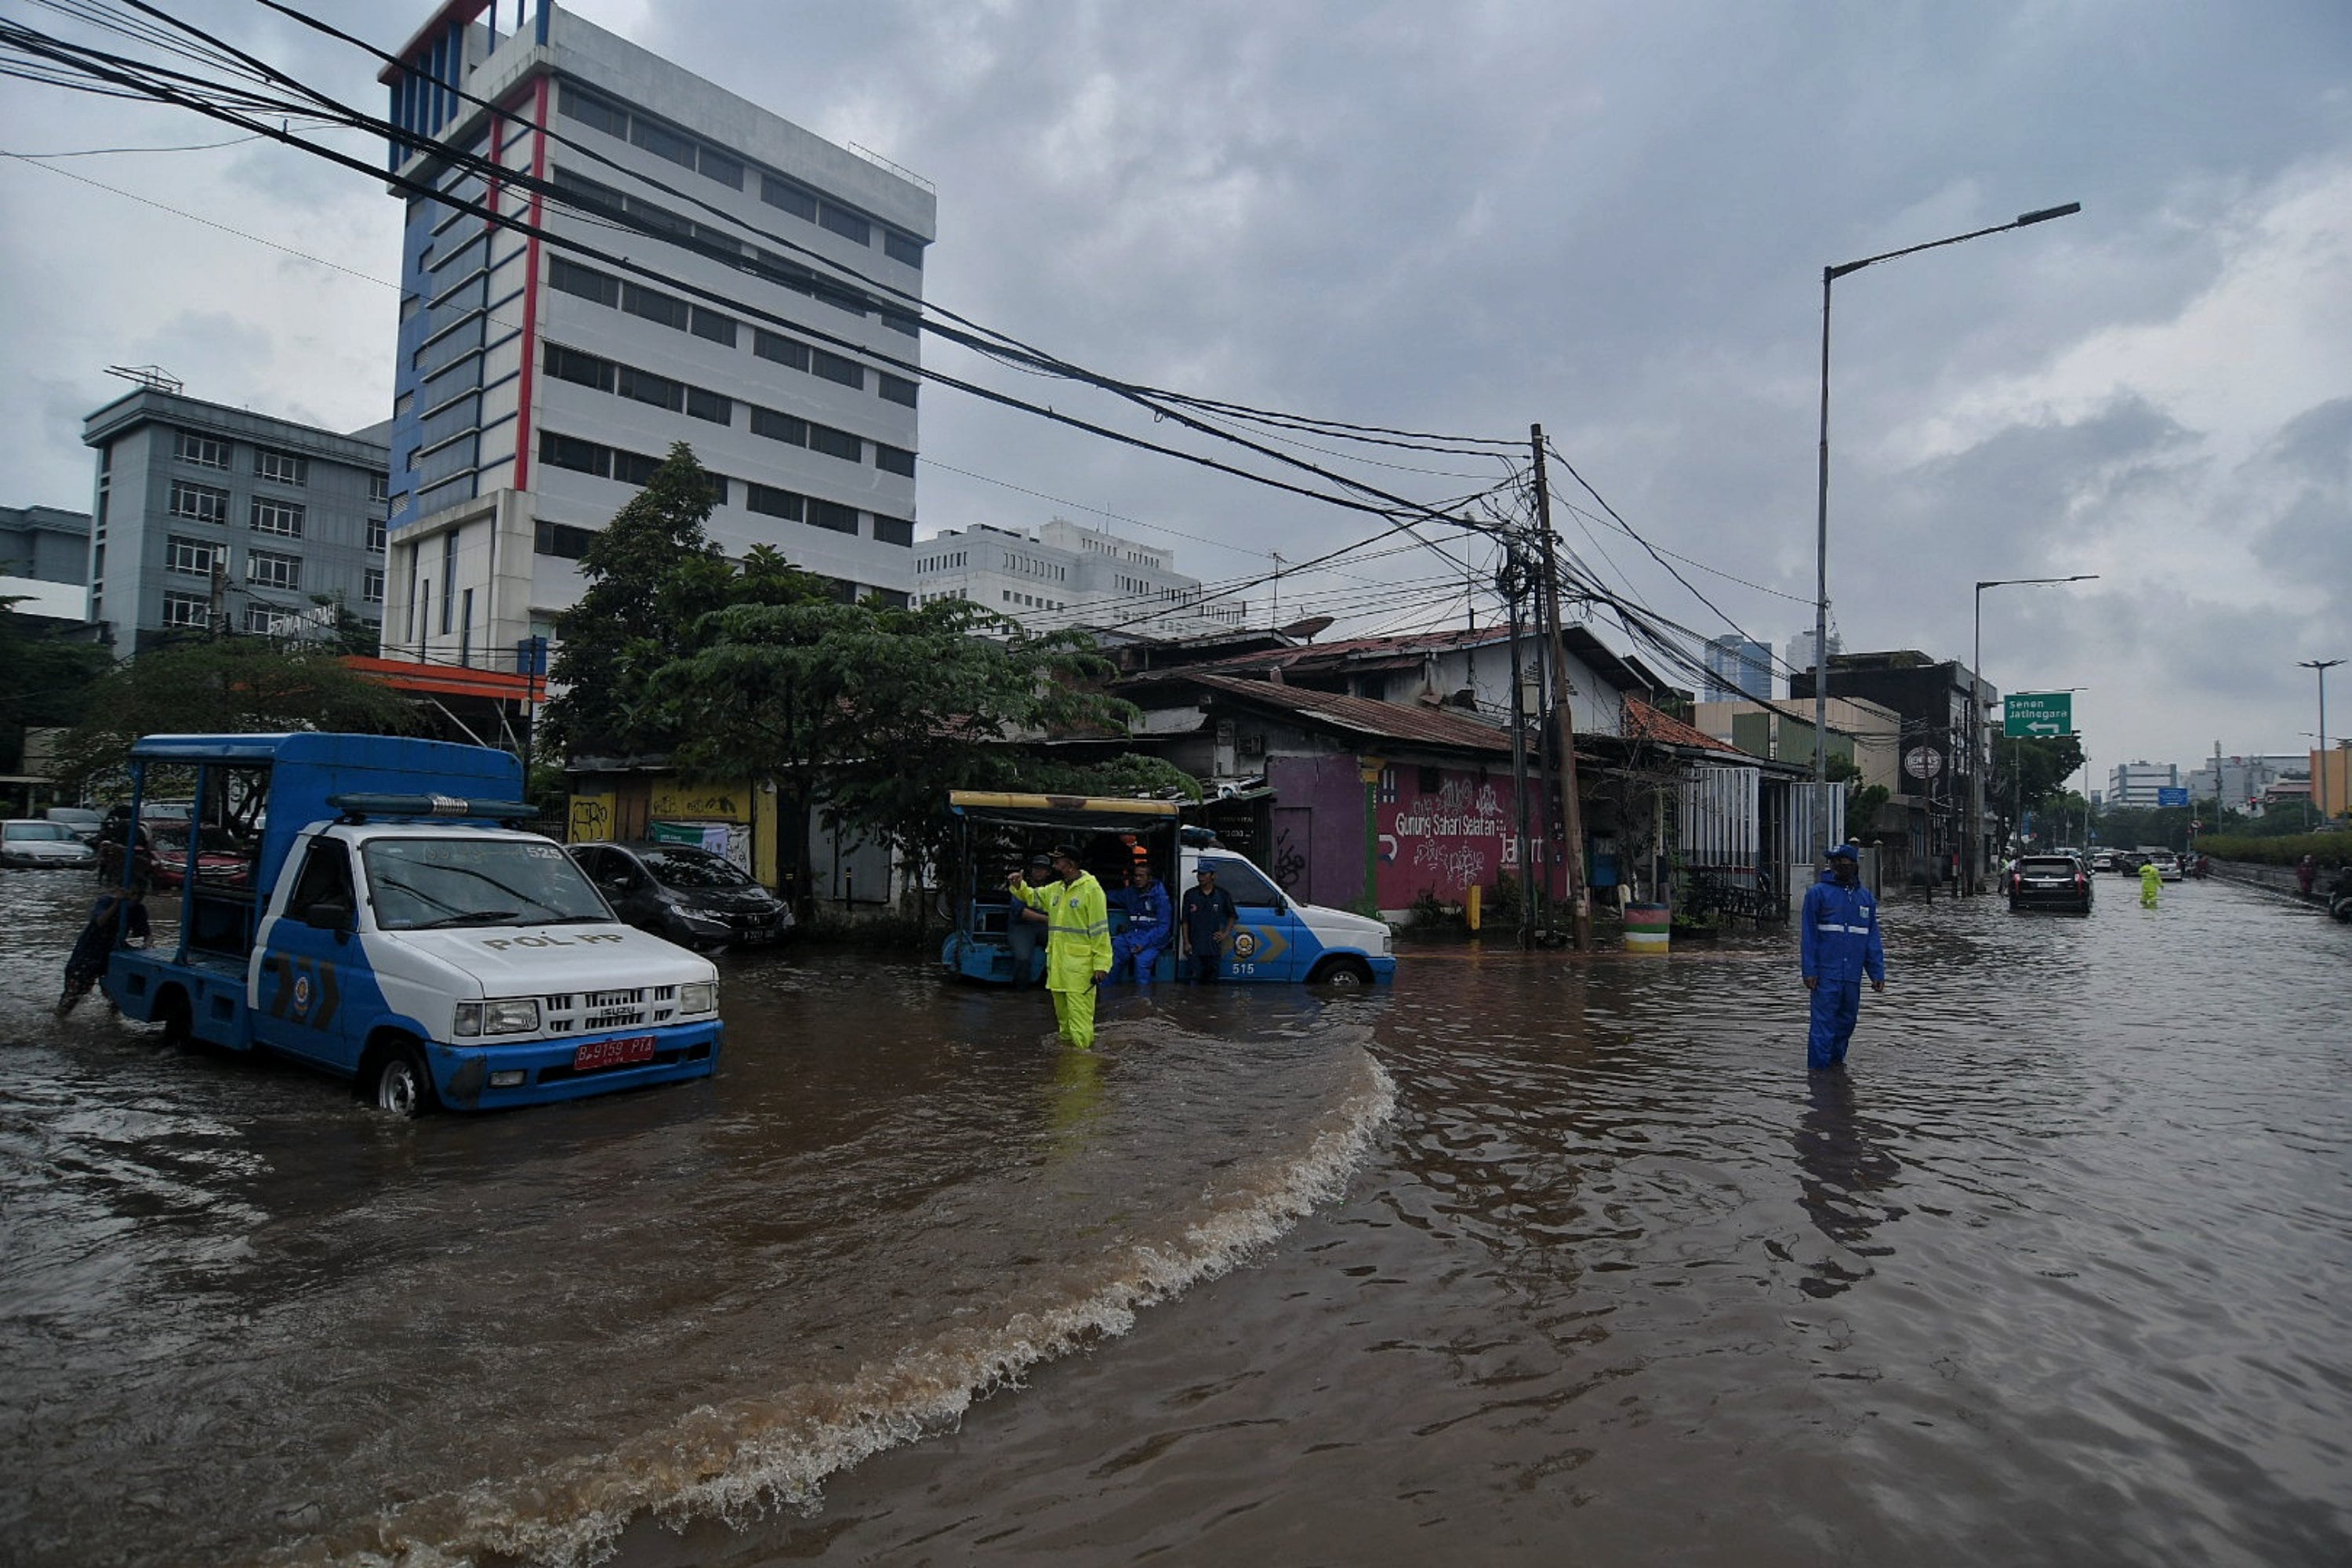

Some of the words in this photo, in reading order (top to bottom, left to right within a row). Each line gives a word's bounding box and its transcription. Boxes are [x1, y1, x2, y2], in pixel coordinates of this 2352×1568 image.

[2009, 700, 2044, 709] Senen
[2009, 710, 2067, 720] Jatinegara
[1396, 812, 1431, 839] Gunung
[1433, 814, 1461, 837] Sahari
[1463, 815, 1495, 837] Selatan
[526, 847, 563, 860] 525
[481, 935, 575, 951] POL
[573, 934, 624, 944] PP
[1232, 963, 1254, 975] 515
[601, 1006, 636, 1017] ISUZU
